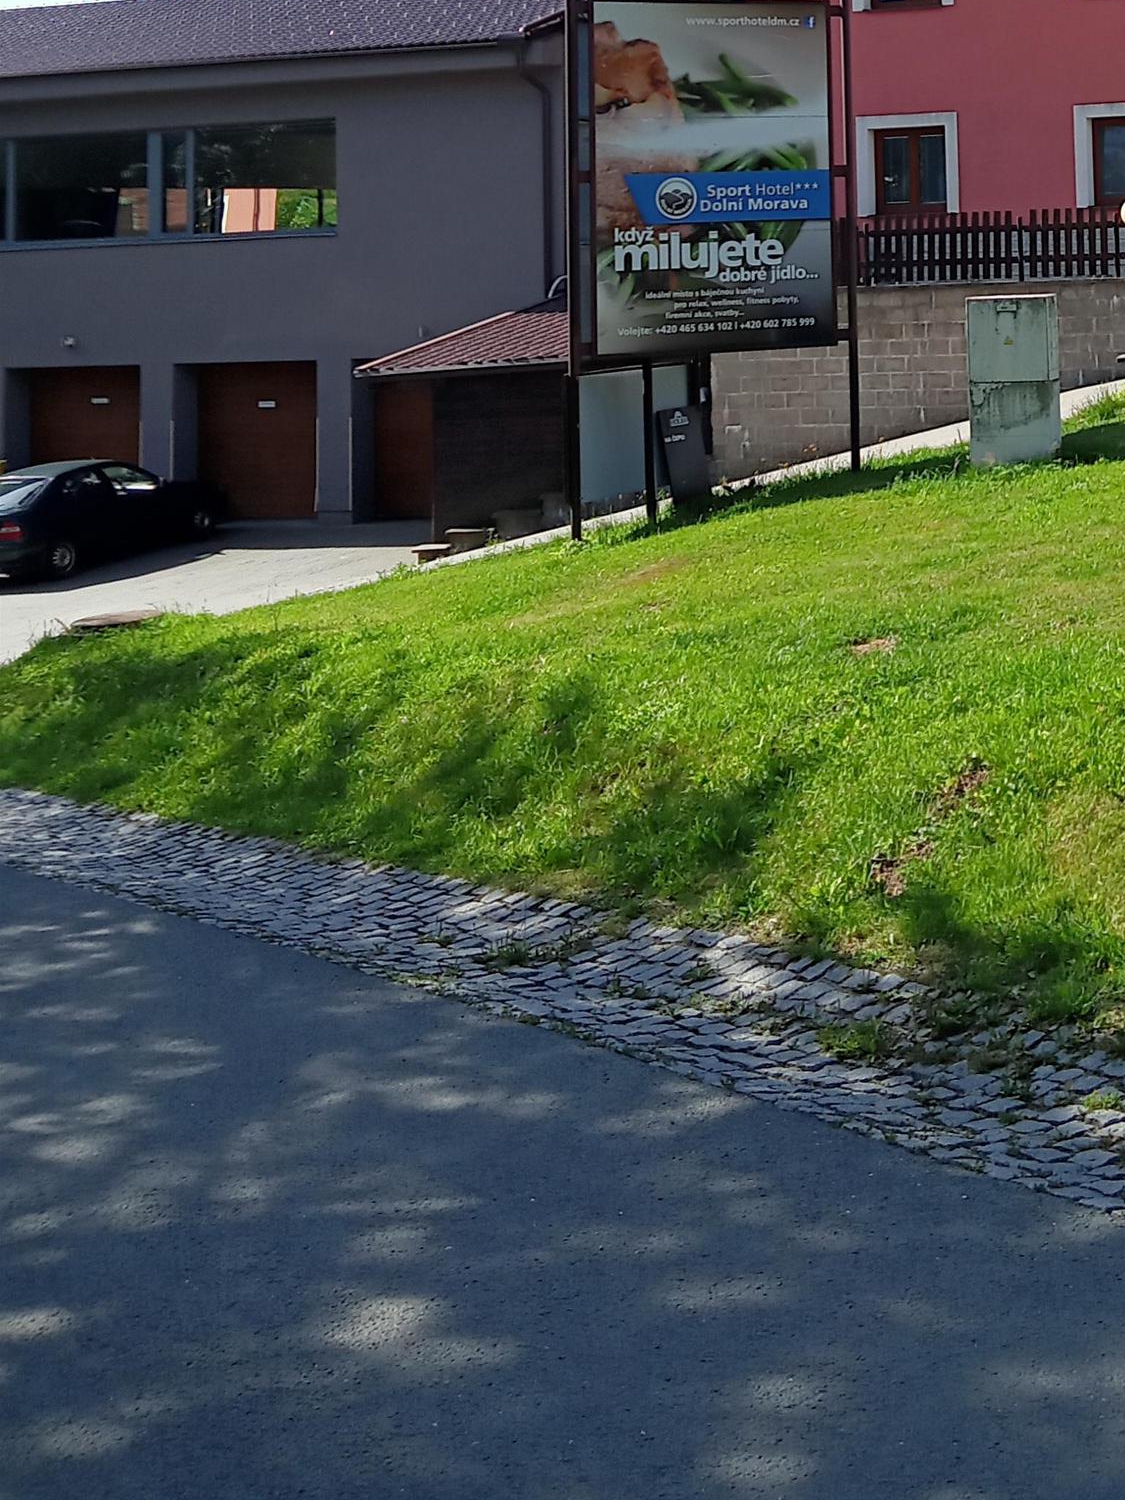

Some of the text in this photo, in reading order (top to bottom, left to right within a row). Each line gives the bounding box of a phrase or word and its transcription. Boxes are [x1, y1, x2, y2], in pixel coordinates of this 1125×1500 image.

[686, 16, 800, 27] www.sporthoteldm.cz
[707, 184, 751, 199] Sport
[701, 198, 743, 212] Dolní
[748, 198, 808, 210] Morava
[614, 227, 654, 245] když
[614, 231, 784, 278] milujete
[719, 267, 767, 283] dobré
[655, 325, 677, 334] +420
[680, 323, 696, 332] 465
[698, 322, 715, 332] 634
[717, 322, 732, 331] 102
[740, 320, 761, 330] +420
[763, 319, 779, 328] 602
[781, 318, 797, 327] 785
[799, 317, 815, 326] 999
